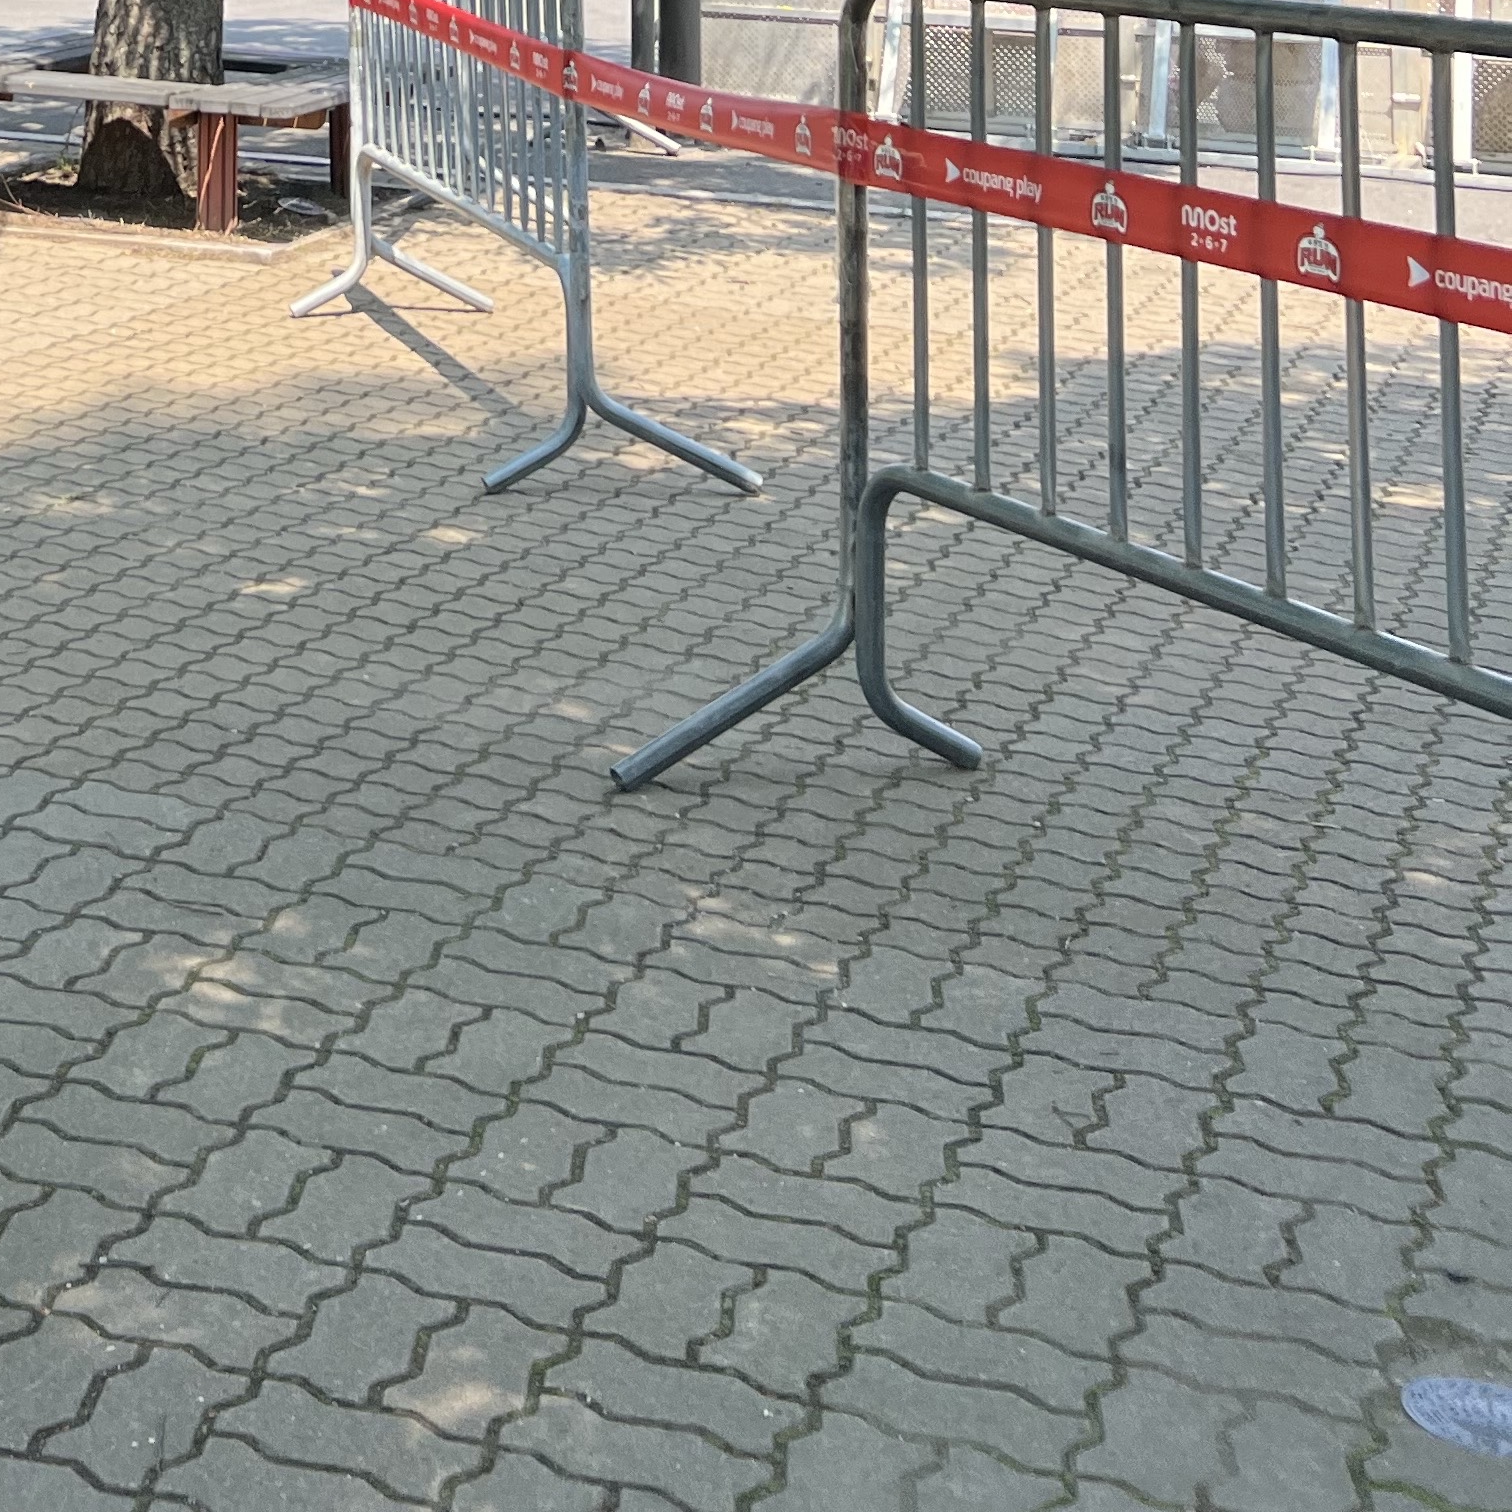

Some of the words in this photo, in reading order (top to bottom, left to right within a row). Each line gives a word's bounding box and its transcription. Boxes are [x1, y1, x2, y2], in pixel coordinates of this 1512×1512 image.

[962, 167, 1014, 198] coupang
[1015, 174, 1043, 204] play
[1300, 246, 1337, 277] RUN
[1434, 269, 1512, 309] coupang
